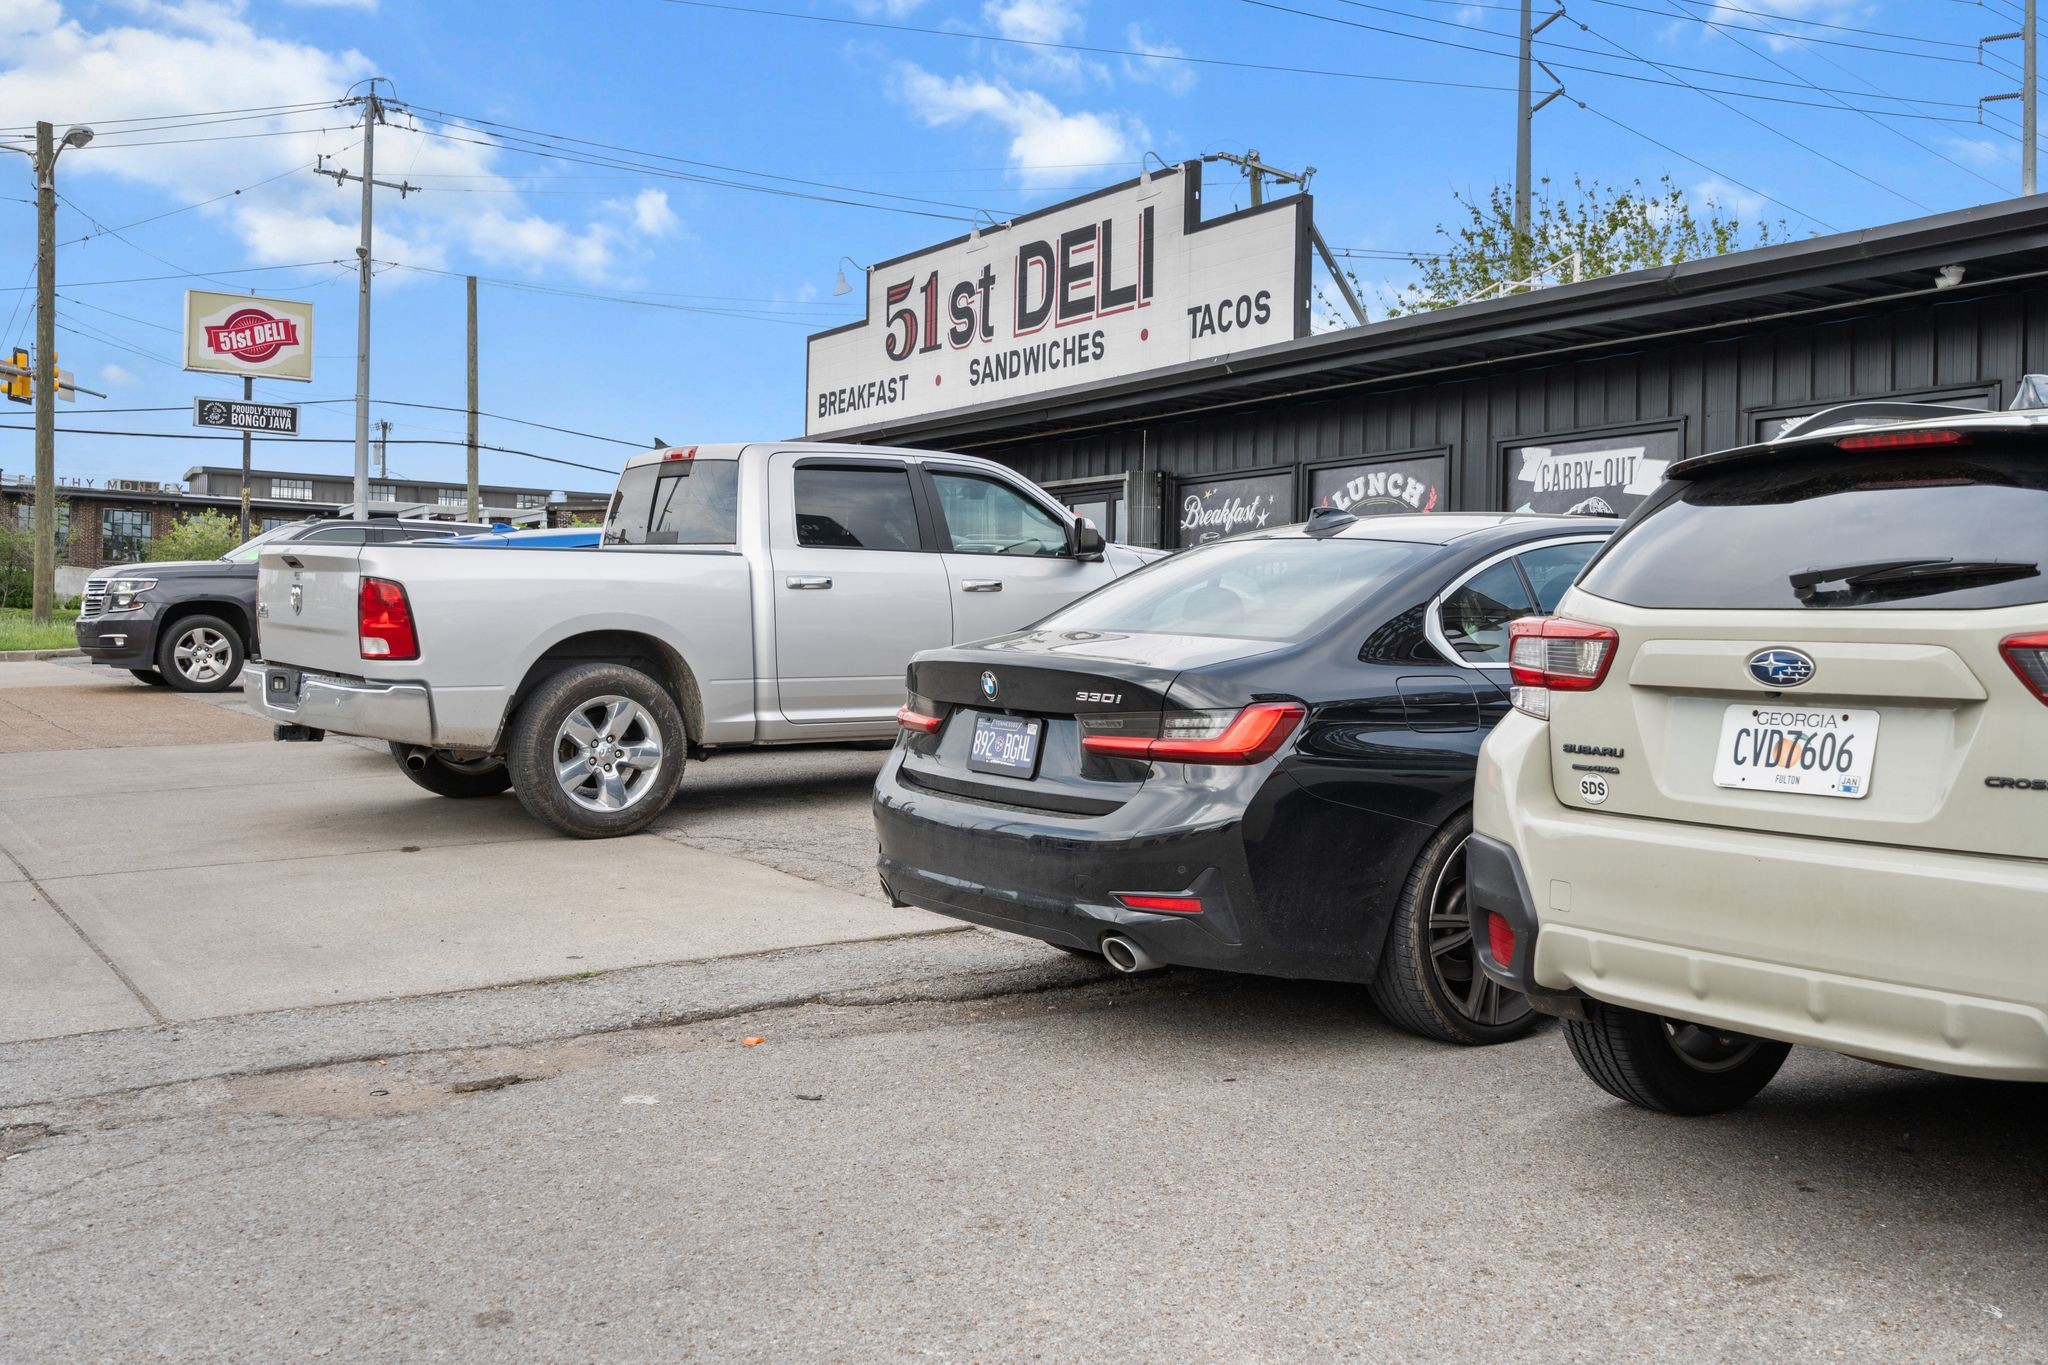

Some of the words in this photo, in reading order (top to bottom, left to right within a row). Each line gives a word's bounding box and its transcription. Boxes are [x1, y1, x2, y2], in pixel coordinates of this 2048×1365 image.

[885, 263, 996, 362] 51st
[1014, 205, 1155, 338] DELI
[219, 329, 253, 351] 51st
[253, 322, 286, 344] DELI
[818, 374, 909, 418] BREAKFAST
[969, 330, 1105, 386] SANDWICHES
[1187, 289, 1272, 339] TACOS
[231, 404, 262, 415] PROUDLY
[263, 407, 292, 418] SERVING
[231, 413, 266, 427] BONGO
[268, 416, 292, 430] JAVA
[18, 474, 95, 488] FRTHY
[1541, 456, 1637, 491] CARRY-OUT
[1332, 472, 1426, 510] LUNCH
[1180, 494, 1261, 532] Breakfast
[1075, 691, 1123, 704] 330i
[1756, 711, 1838, 729] GEORGIA
[973, 730, 996, 756] 892
[1002, 733, 1031, 762] BGHL
[1562, 743, 1625, 758] SUBARU
[1733, 728, 1855, 773] CVD7606
[1581, 780, 1606, 796] SDS
[1774, 774, 1800, 785] FULTON
[1840, 777, 1858, 786] JAN
[1984, 775, 2048, 791] CROS
